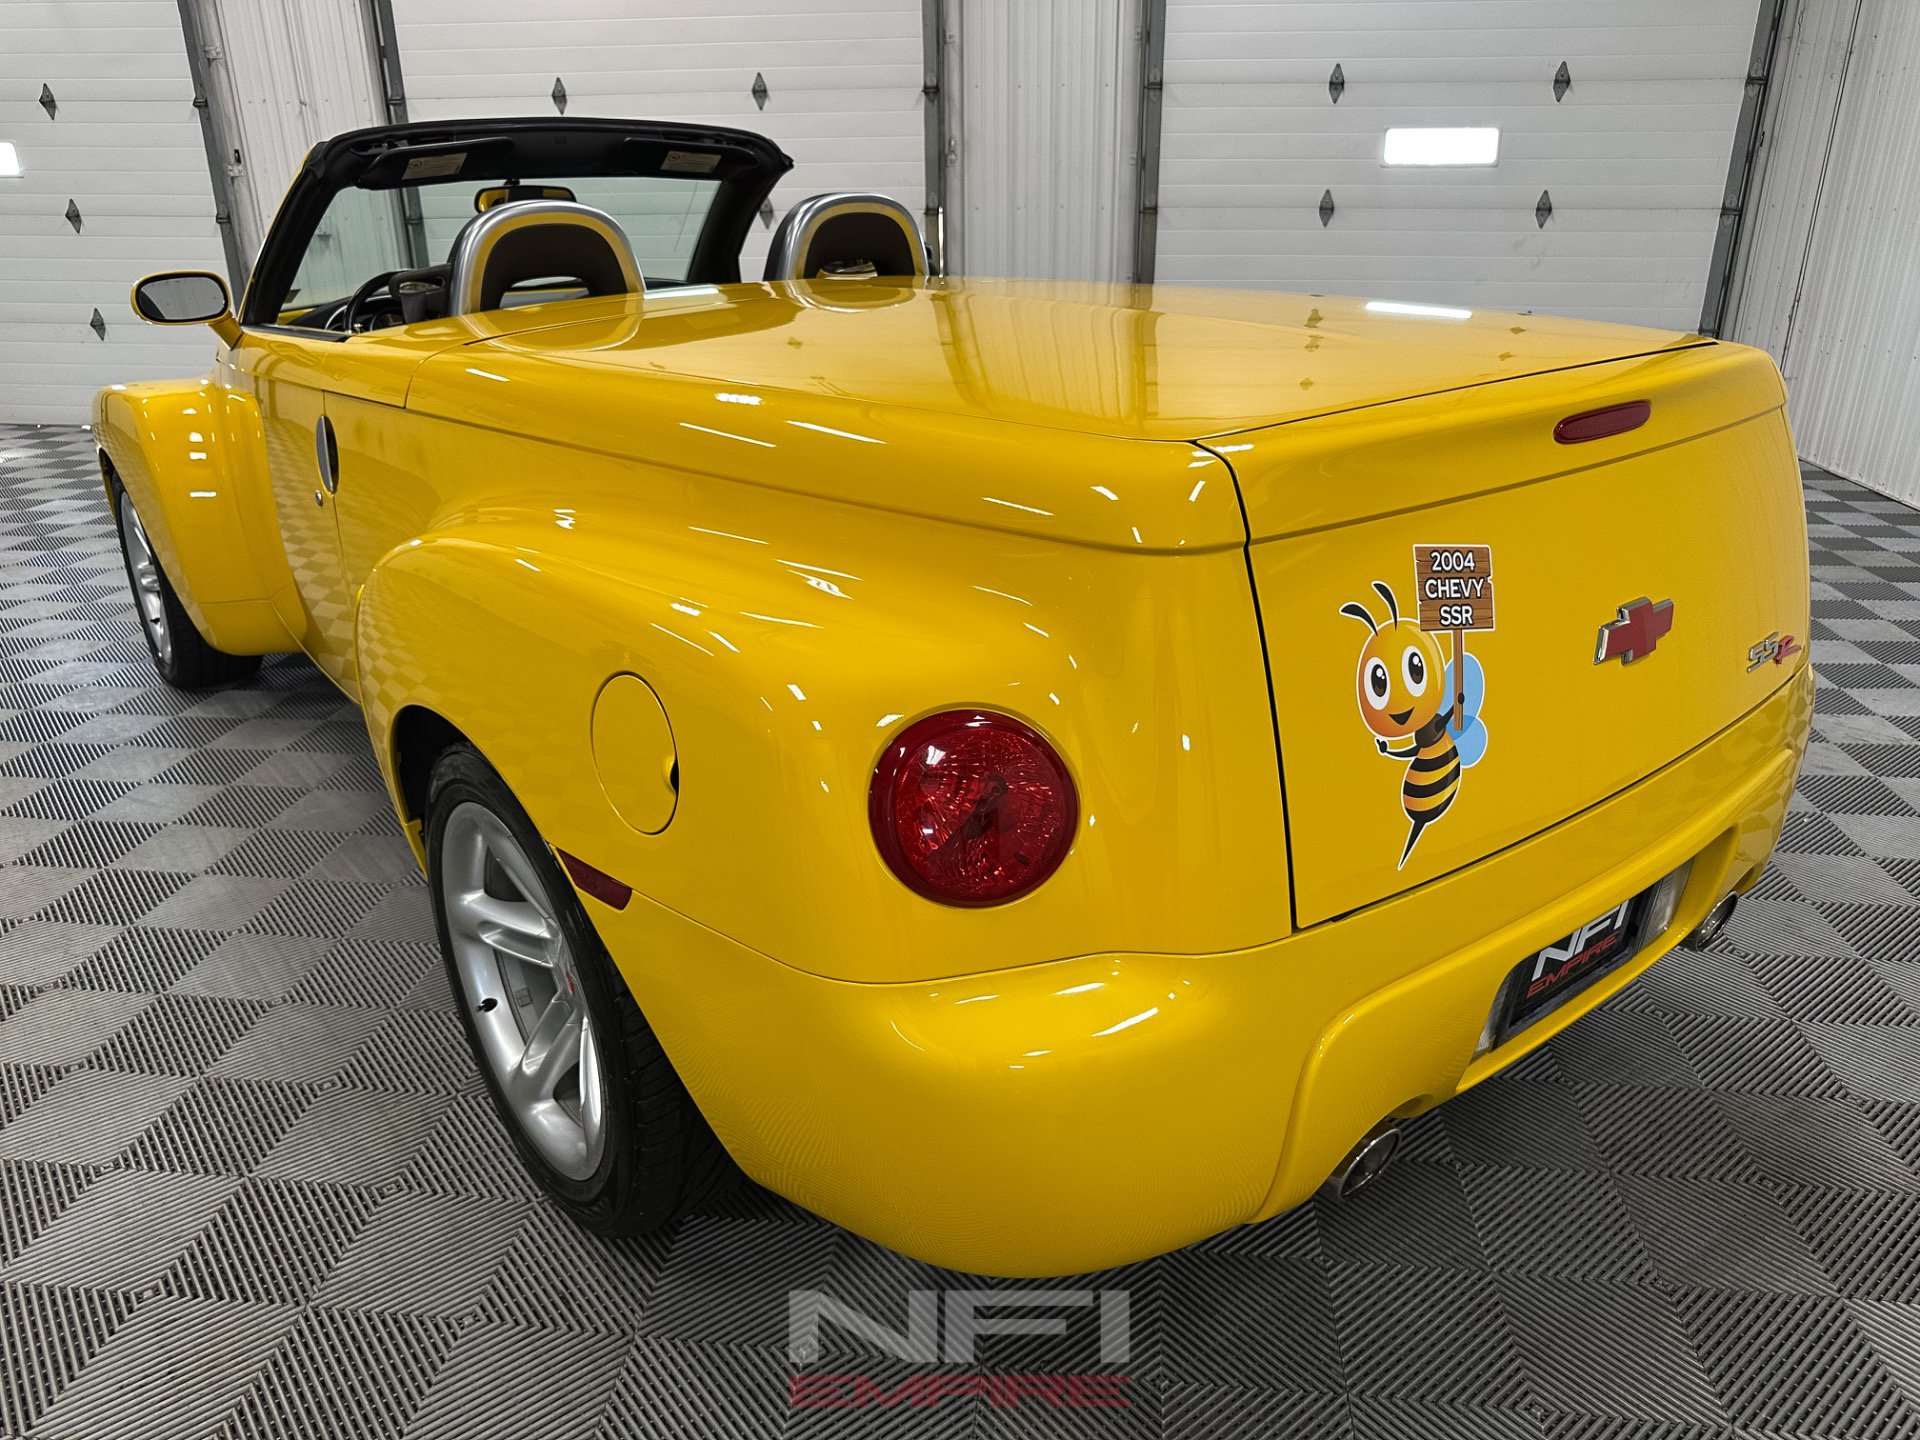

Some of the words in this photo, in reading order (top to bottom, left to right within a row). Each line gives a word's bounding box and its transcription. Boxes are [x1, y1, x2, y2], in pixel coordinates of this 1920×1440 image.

[1430, 551, 1475, 571] 2004
[1425, 578, 1484, 598] CHEVY
[1440, 605, 1473, 625] SSR
[1747, 632, 1802, 673] SSR
[1531, 900, 1629, 982] NFI
[1527, 930, 1620, 999] EMPIRE
